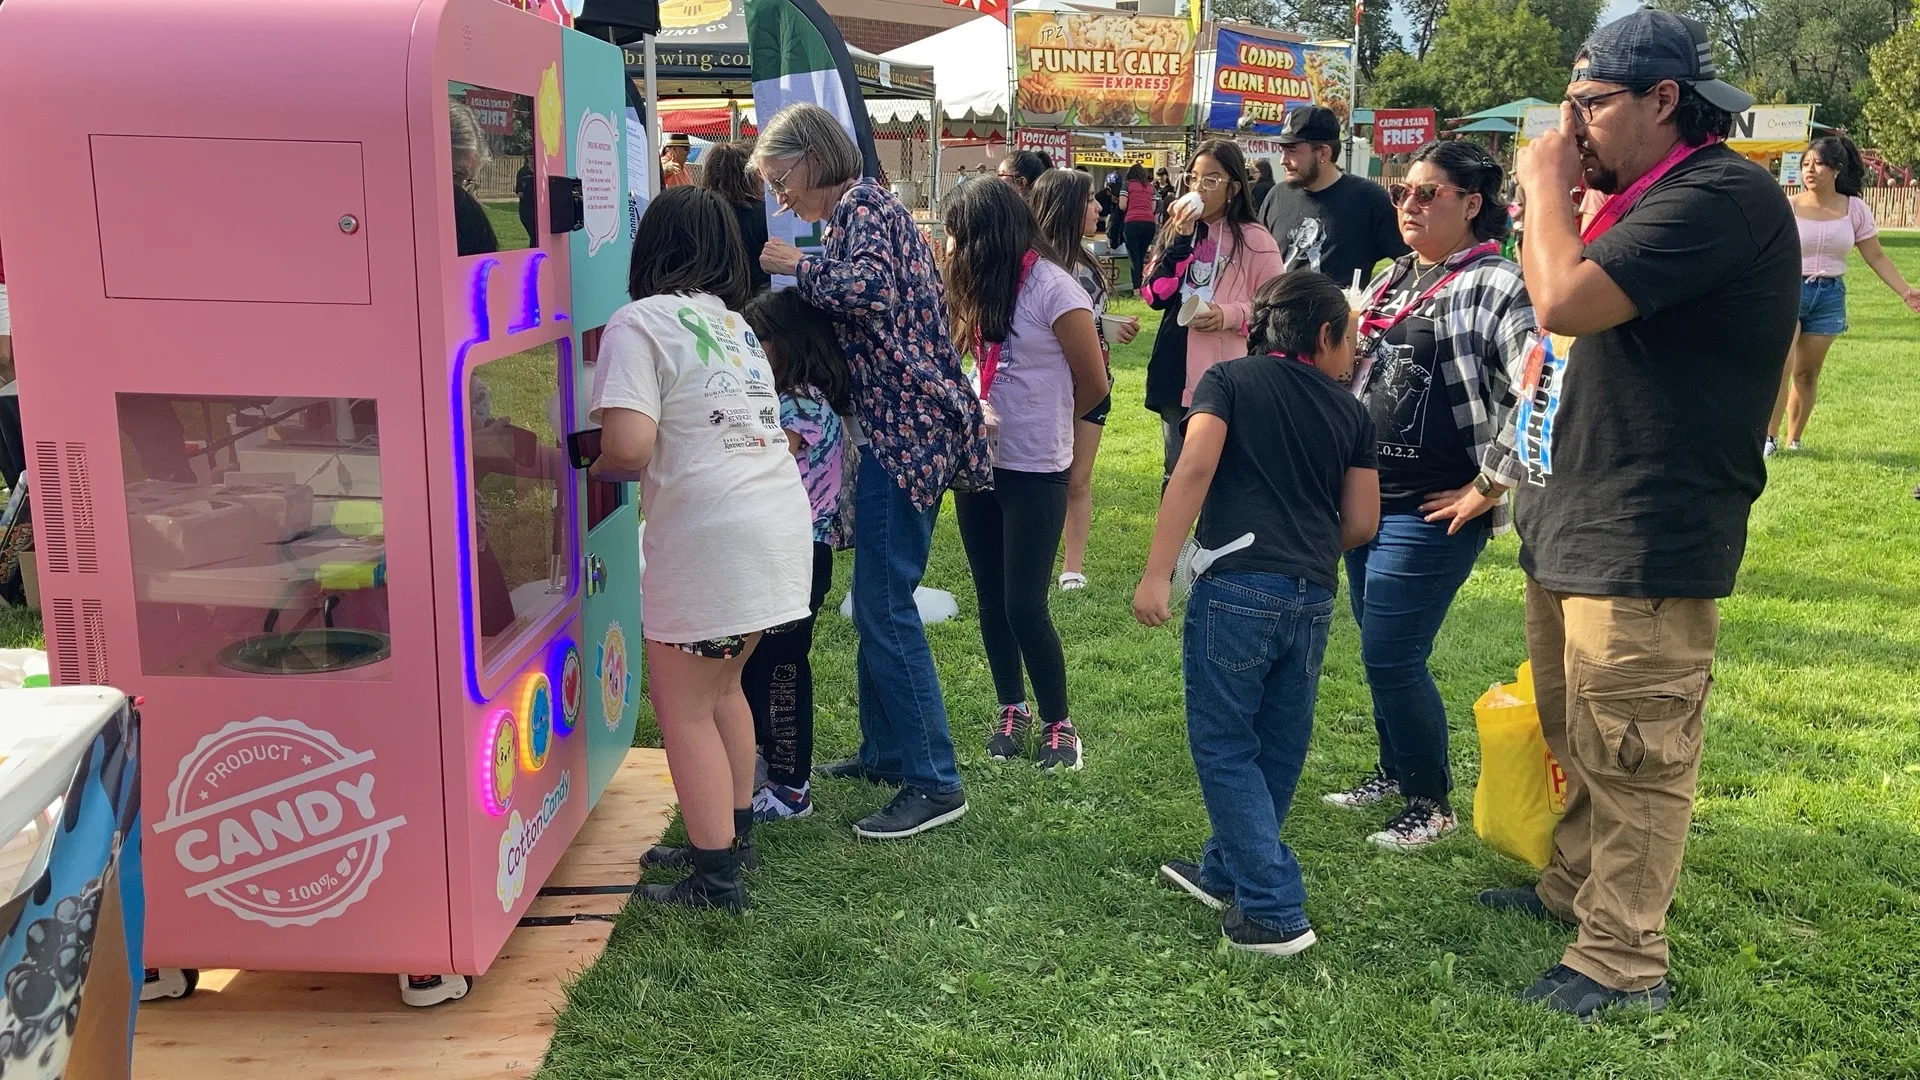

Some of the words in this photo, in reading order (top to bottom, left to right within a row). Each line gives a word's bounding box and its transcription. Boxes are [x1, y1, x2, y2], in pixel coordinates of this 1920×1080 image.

[623, 49, 752, 72] brwing.co
[1030, 48, 1118, 73] FUNNEL
[1123, 51, 1181, 76] CAKE
[1240, 44, 1295, 71] LOADED
[1105, 76, 1170, 89] EXPRESS
[1218, 68, 1265, 93] CARNE
[1267, 75, 1310, 99] ASADA
[1244, 99, 1285, 122] FRIES
[1378, 118, 1404, 127] CARNE
[1404, 117, 1429, 126] ASADA
[1021, 131, 1044, 144] FOOT
[1044, 134, 1067, 145] LONG
[1382, 128, 1425, 145] FRIES
[1084, 156, 1145, 164] BURRITO
[759, 416, 775, 424] THE
[1527, 364, 1555, 488] GOHAN
[1377, 445, 1419, 459] .0.2.2.
[769, 682, 797, 738] HELLO
[204, 744, 293, 789] PRODUCT
[174, 772, 376, 873] CANDY
[287, 873, 339, 902] 100%
